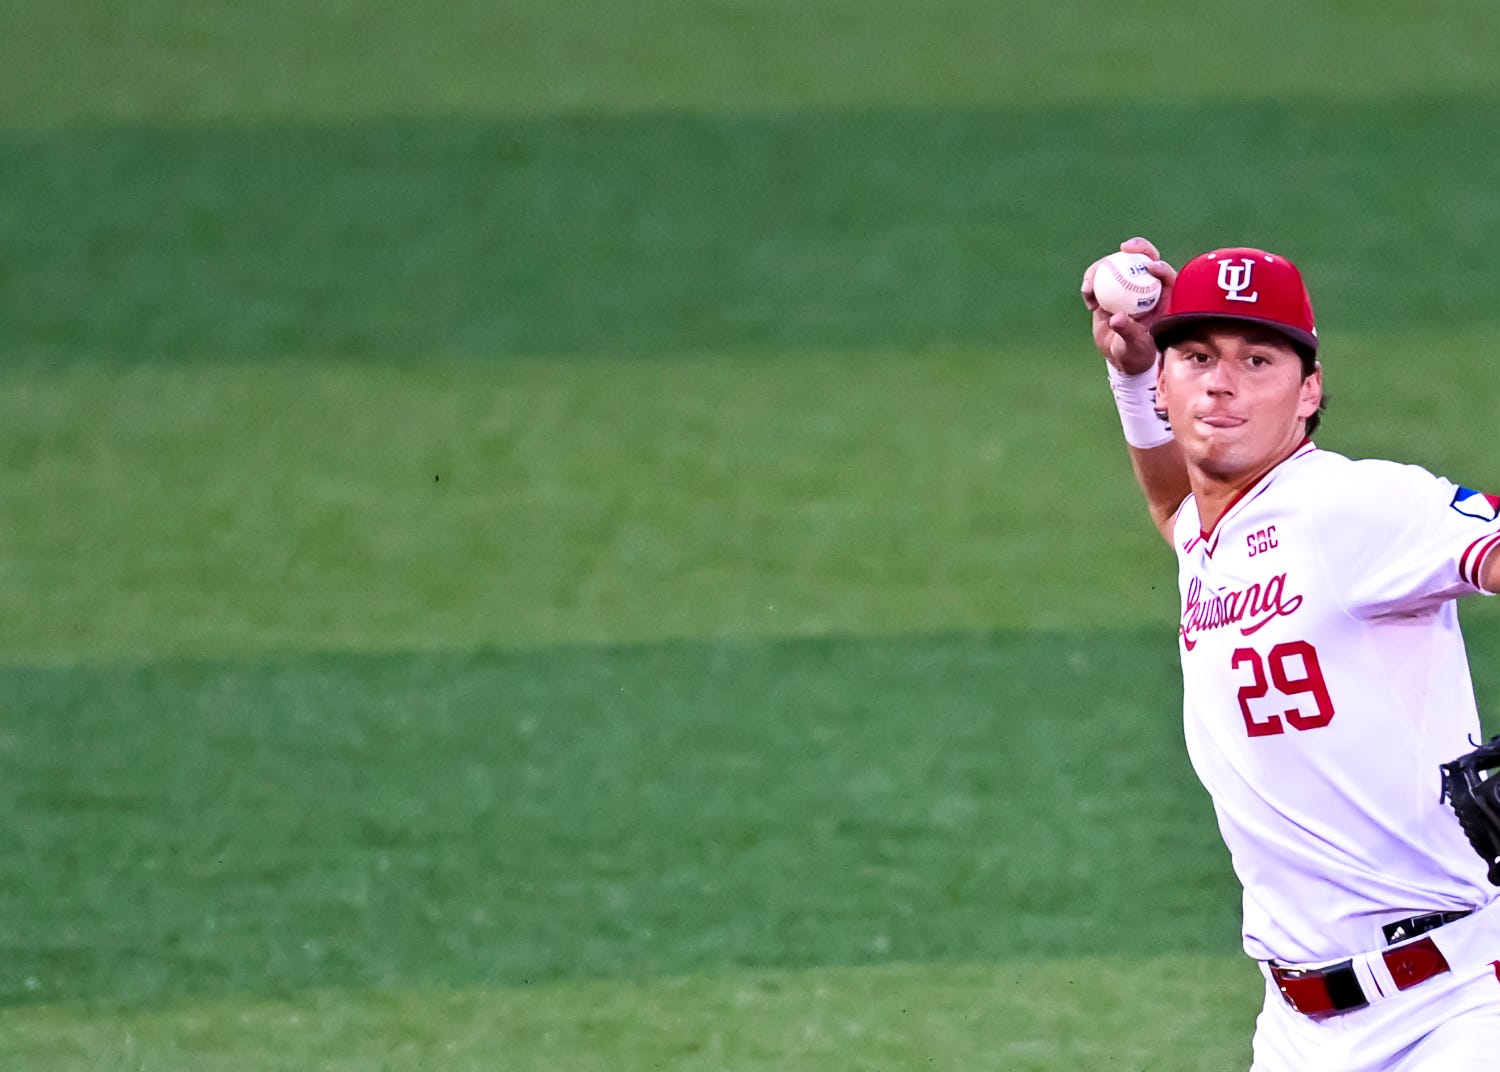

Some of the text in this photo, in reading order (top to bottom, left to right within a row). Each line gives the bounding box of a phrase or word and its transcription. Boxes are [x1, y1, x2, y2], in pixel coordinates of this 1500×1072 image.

[1217, 258, 1258, 303] UL
[1247, 525, 1278, 557] SBC
[1231, 640, 1335, 737] 29
